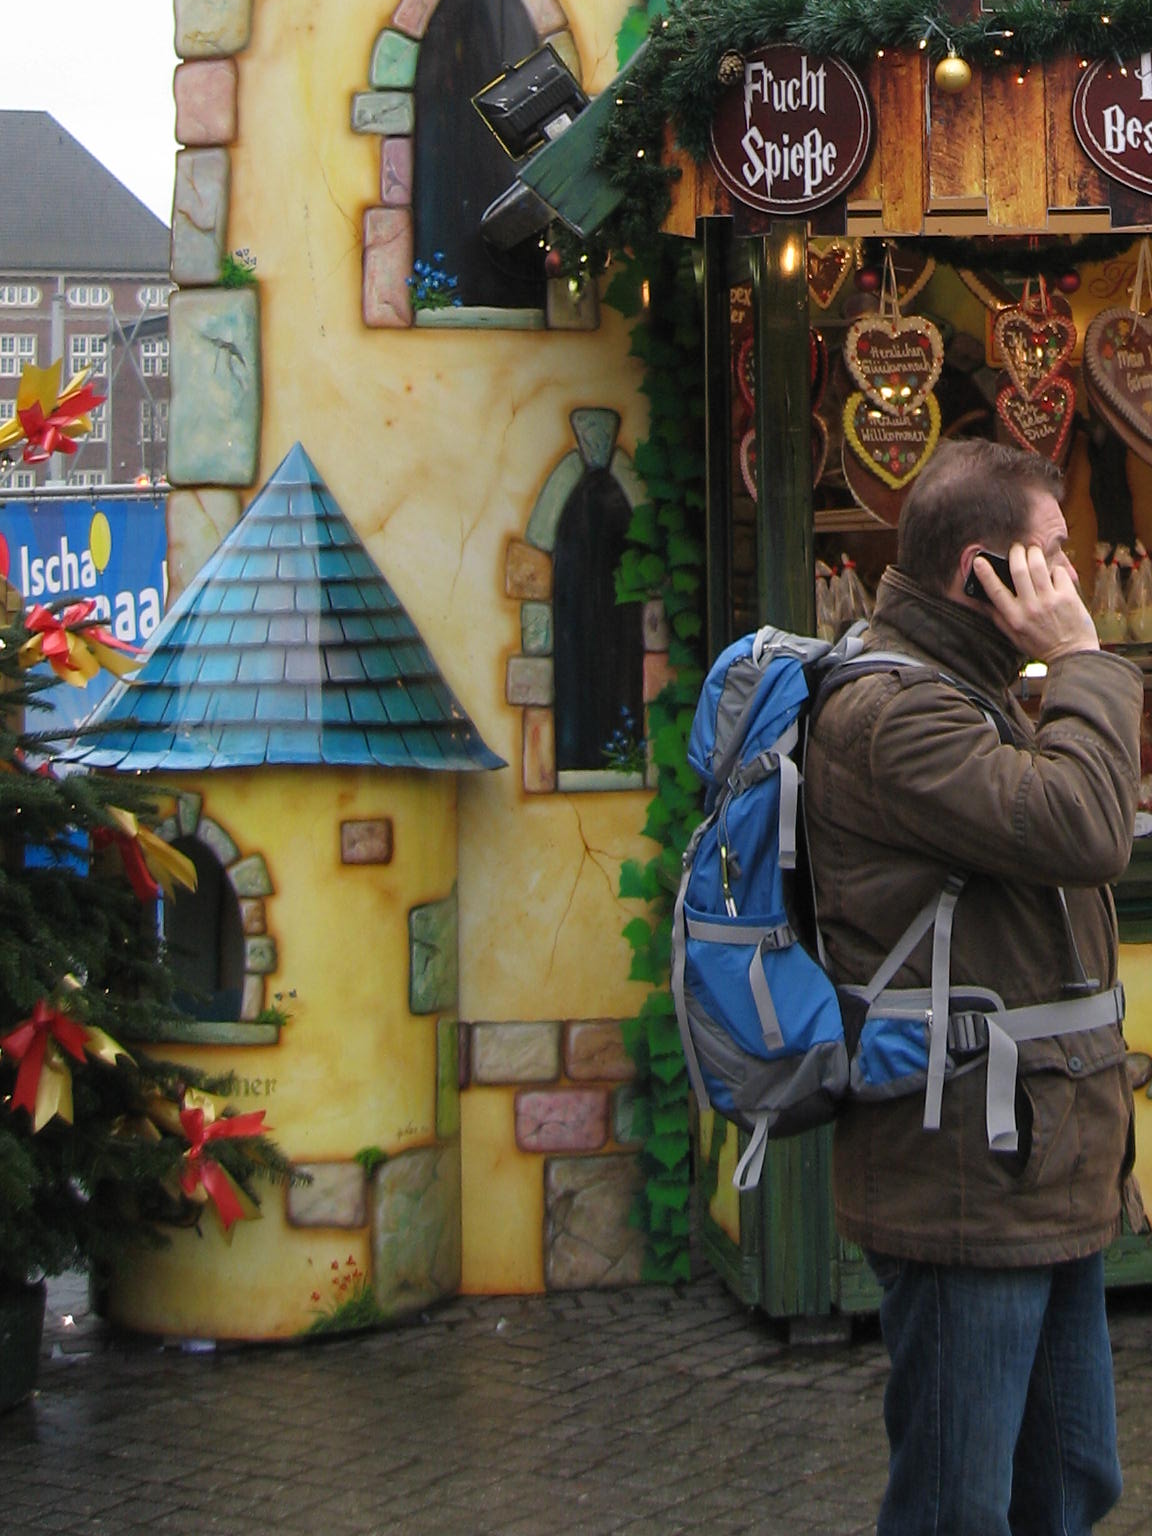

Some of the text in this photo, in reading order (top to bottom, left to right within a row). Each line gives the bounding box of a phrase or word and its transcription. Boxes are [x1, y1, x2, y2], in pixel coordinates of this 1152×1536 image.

[744, 56, 828, 130] Frucht
[741, 126, 837, 198] Spieße
[861, 427, 930, 443] Willkommen
[20, 535, 97, 598] Ischa
